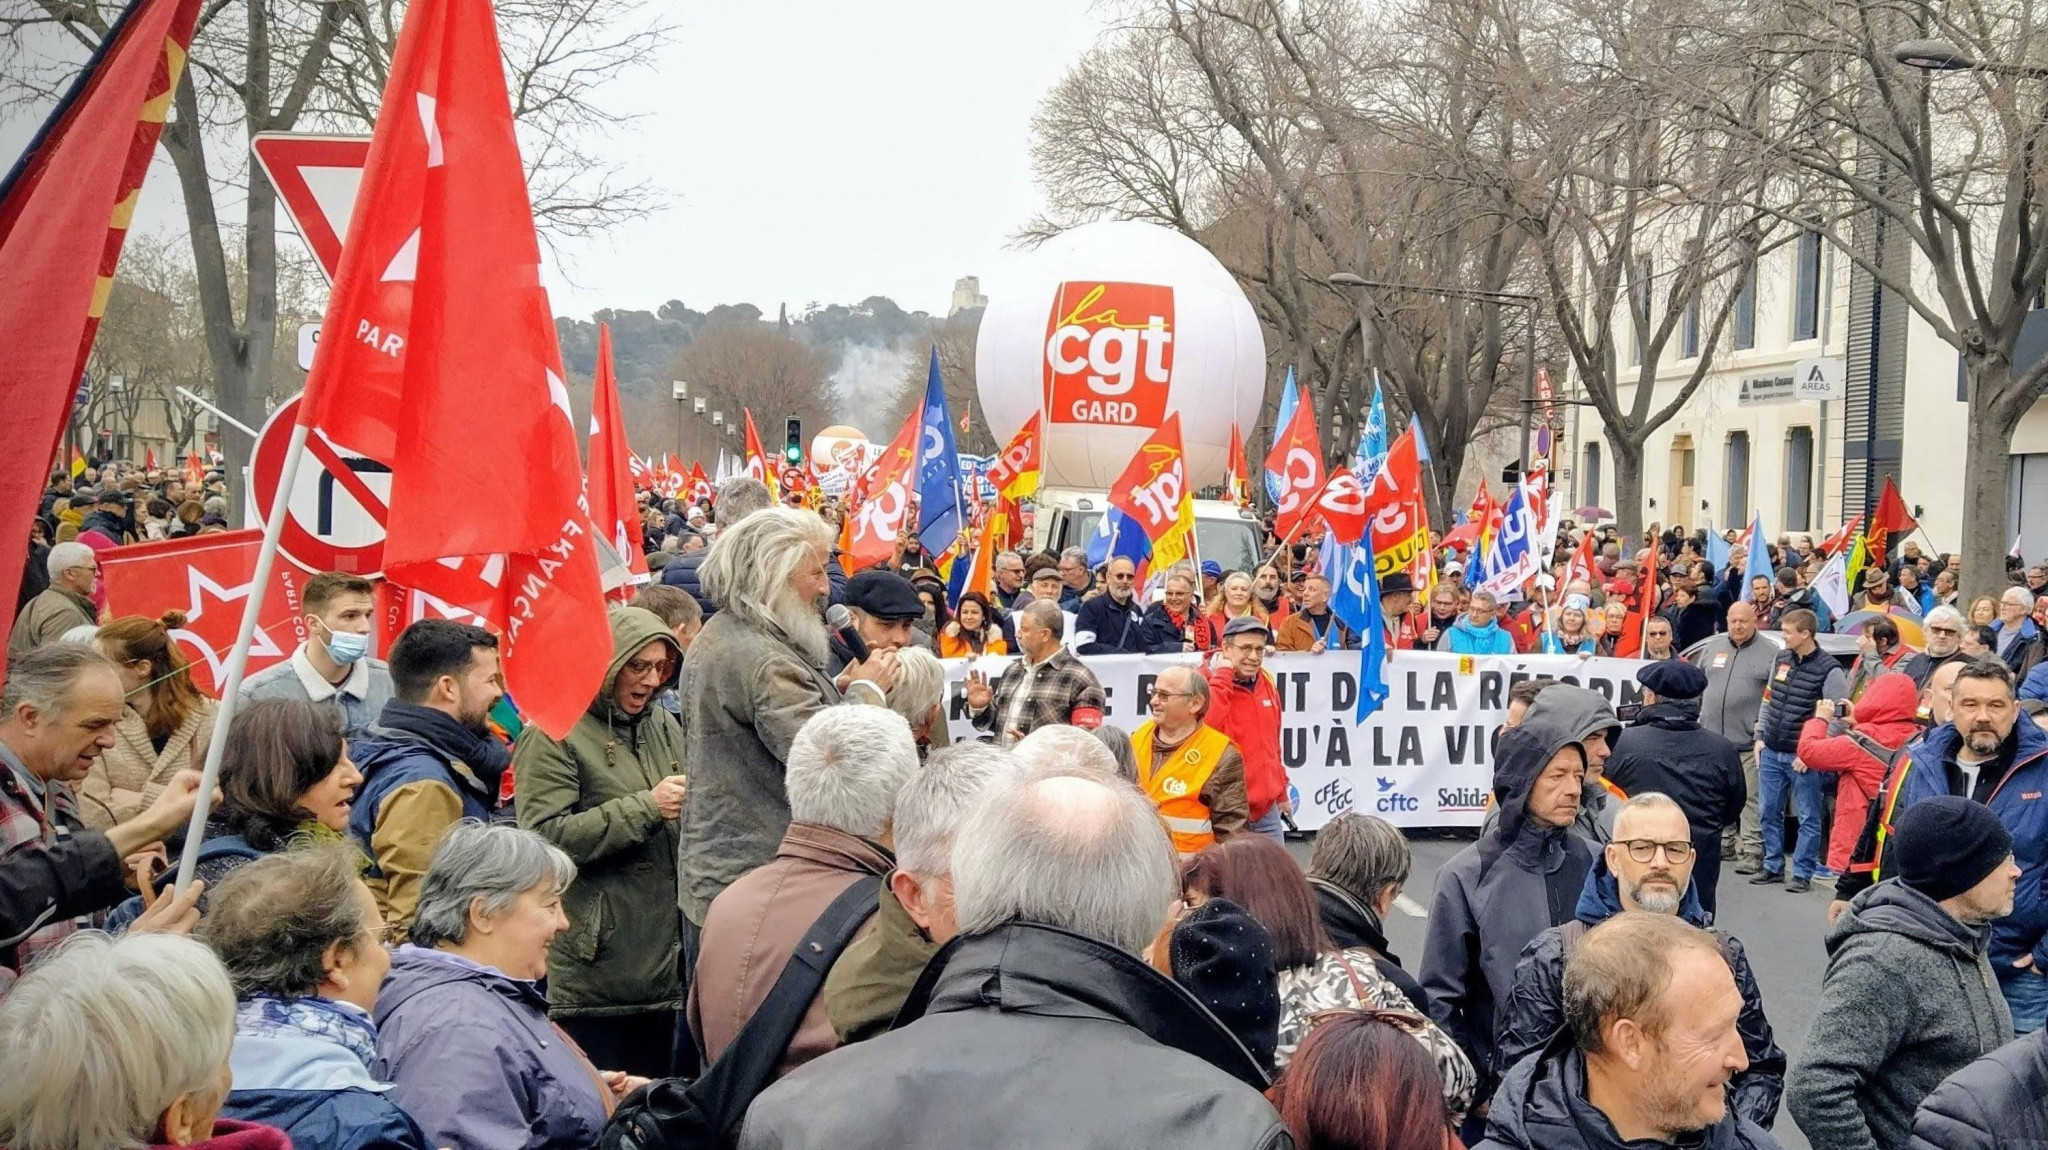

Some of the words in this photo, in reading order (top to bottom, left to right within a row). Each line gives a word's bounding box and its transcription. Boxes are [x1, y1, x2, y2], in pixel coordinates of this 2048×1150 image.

[1046, 314, 1172, 395] cgt
[1801, 382, 1831, 391] AREAS
[1071, 399, 1138, 423] GARD
[1406, 671, 1458, 711] LA
[1373, 725, 1424, 767] LA
[1314, 778, 1340, 806] CFE
[1327, 788, 1352, 815] CGC
[1376, 792, 1418, 812] cftc
[1437, 787, 1489, 807] Solida
